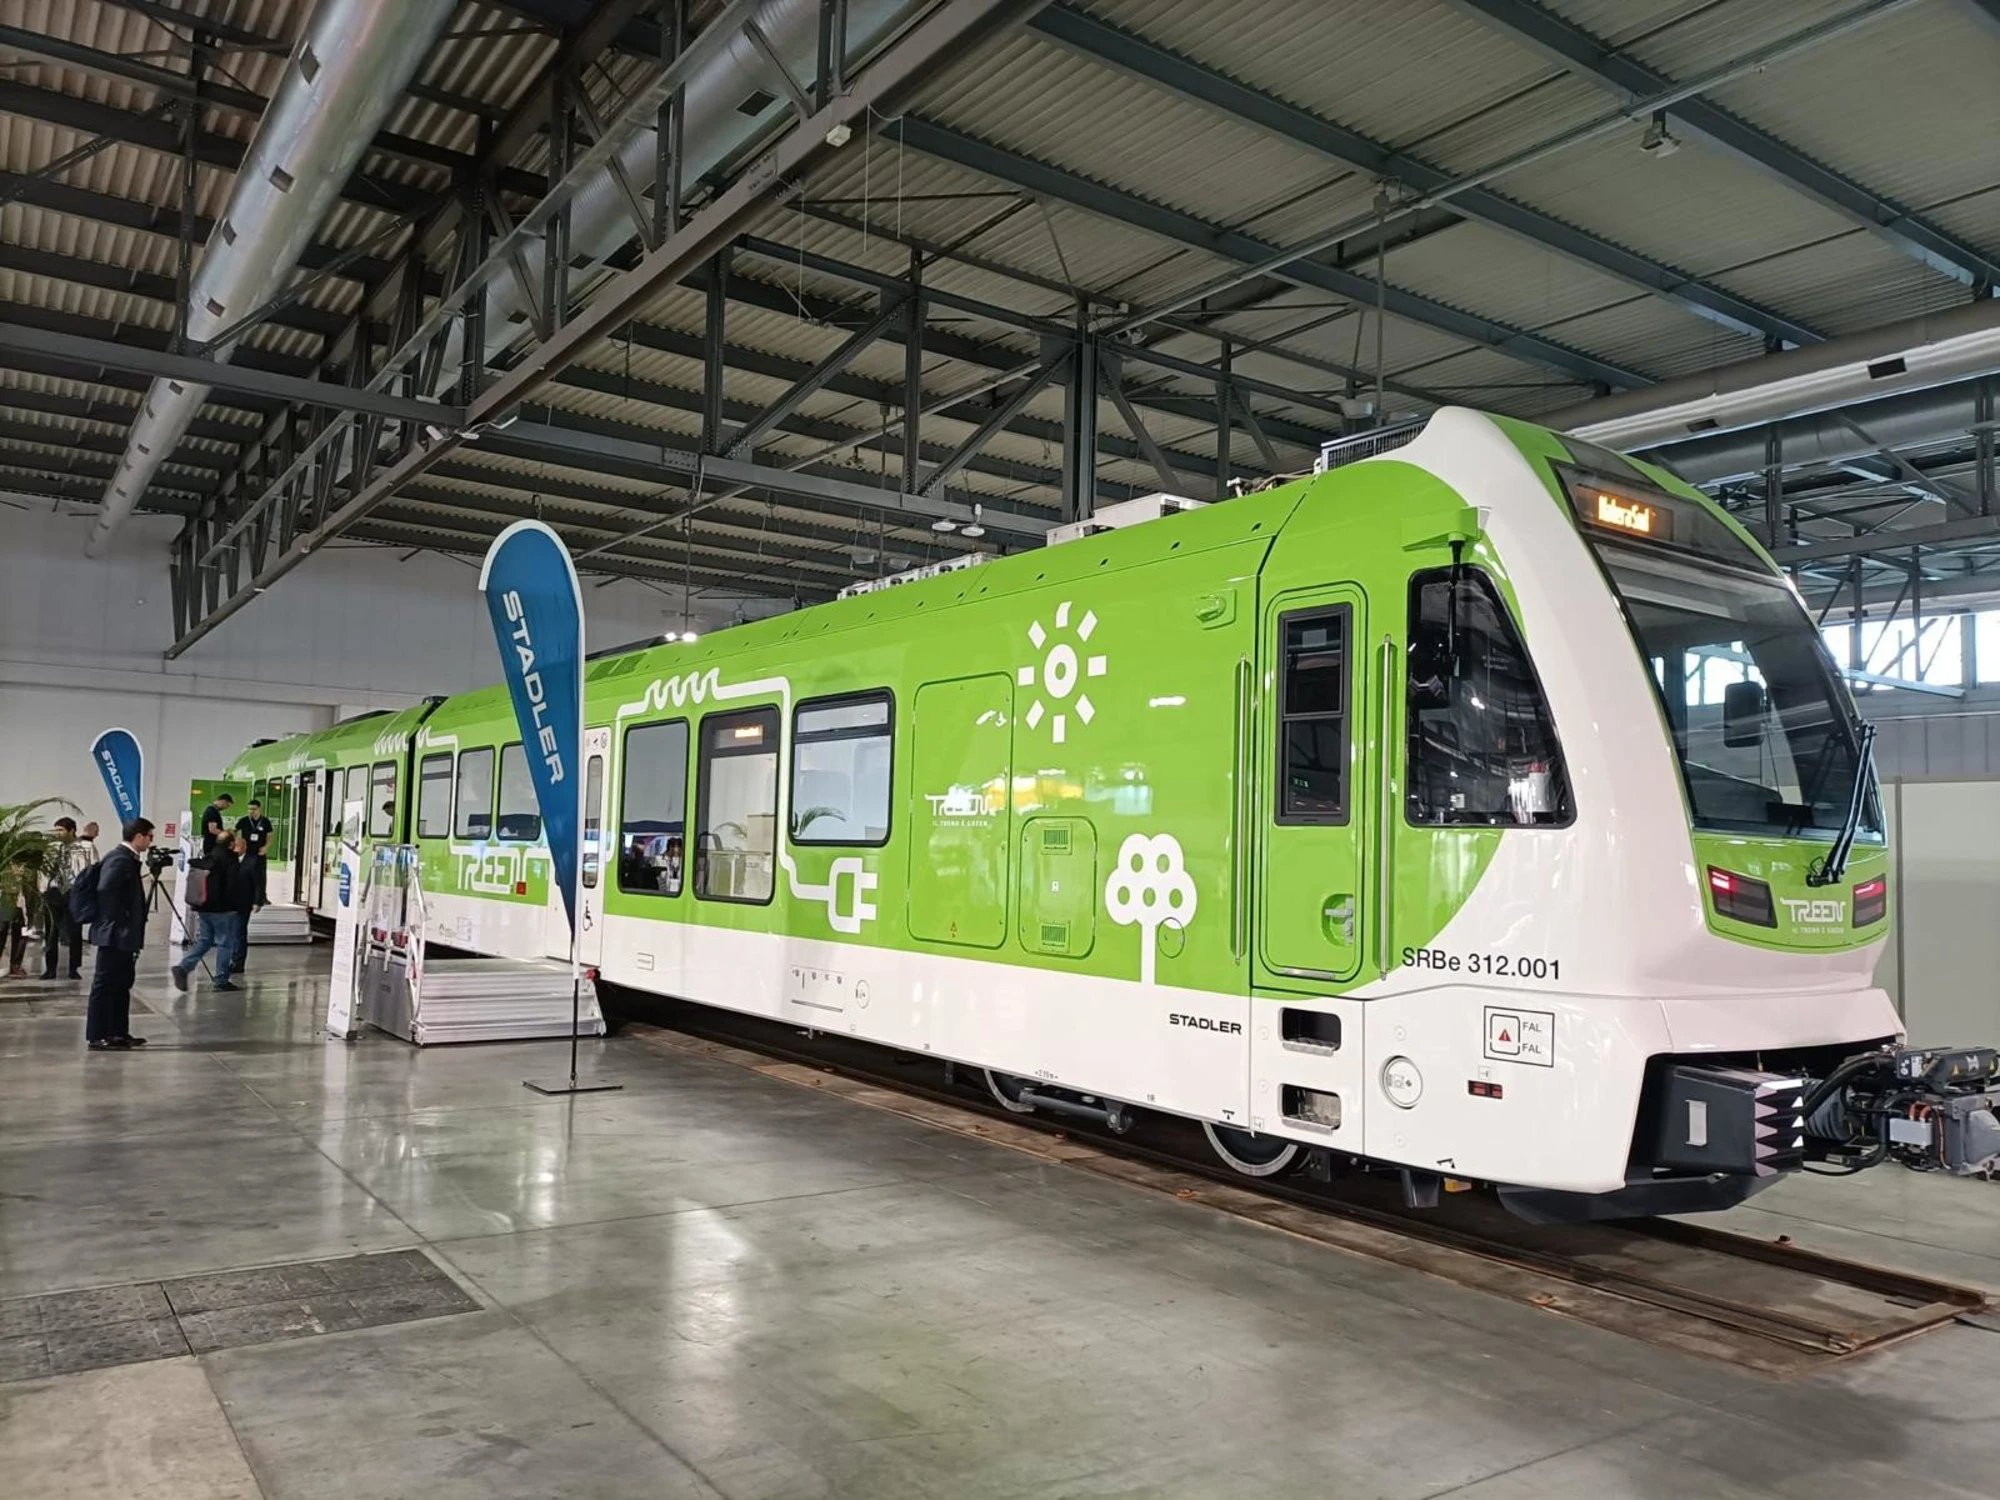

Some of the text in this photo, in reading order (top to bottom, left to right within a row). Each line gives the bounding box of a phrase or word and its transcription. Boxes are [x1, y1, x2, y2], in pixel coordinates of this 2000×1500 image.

[502, 590, 564, 784] STADLER
[101, 750, 133, 812] STADLER
[1780, 897, 1847, 922] TREEN
[1402, 947, 1560, 980] SRBe 312.001
[1169, 1013, 1242, 1035] STADLER
[1522, 1021, 1542, 1032] FAL
[1522, 1043, 1542, 1054] FAL
